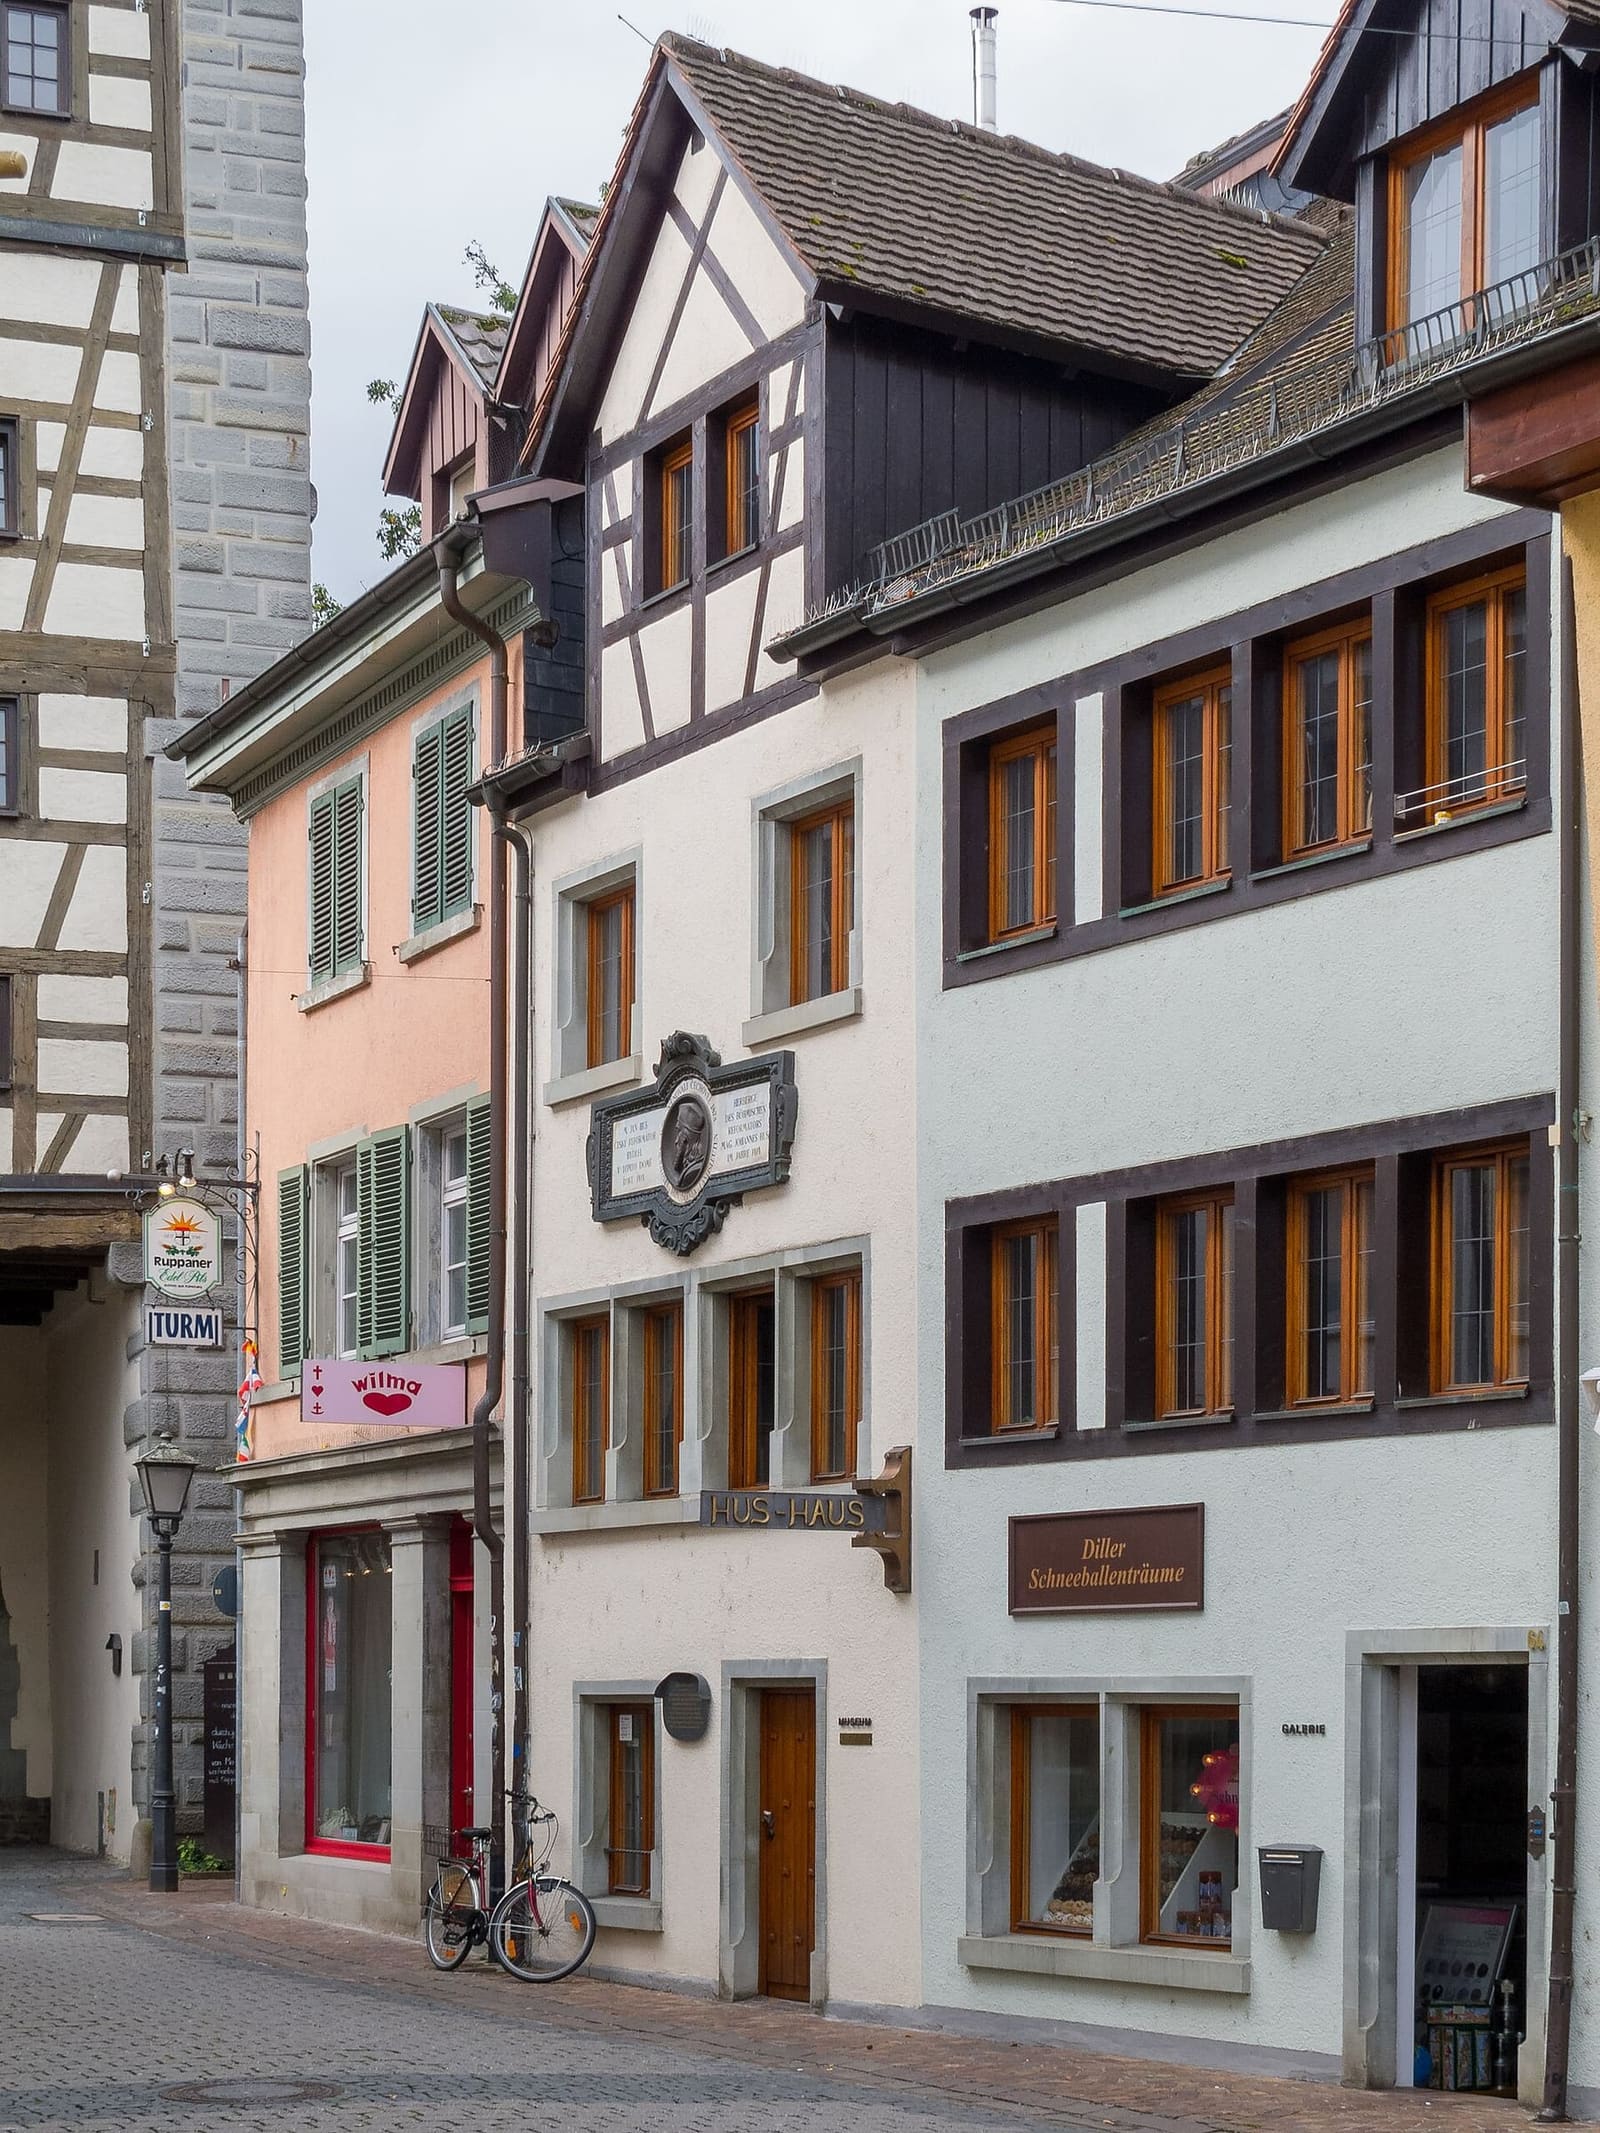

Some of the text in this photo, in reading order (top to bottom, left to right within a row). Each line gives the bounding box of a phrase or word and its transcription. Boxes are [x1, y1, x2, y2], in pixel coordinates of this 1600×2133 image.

[153, 1256, 213, 1269] Ruppaner
[159, 1268, 184, 1282] Edel
[153, 1312, 214, 1339] TURM
[351, 1370, 423, 1396] wilma
[1081, 1537, 1127, 1561] Diller
[1028, 1563, 1185, 1590] Schneeballenträume
[838, 1717, 873, 1727] MUSEUM
[1281, 1723, 1326, 1735] GALERIE
